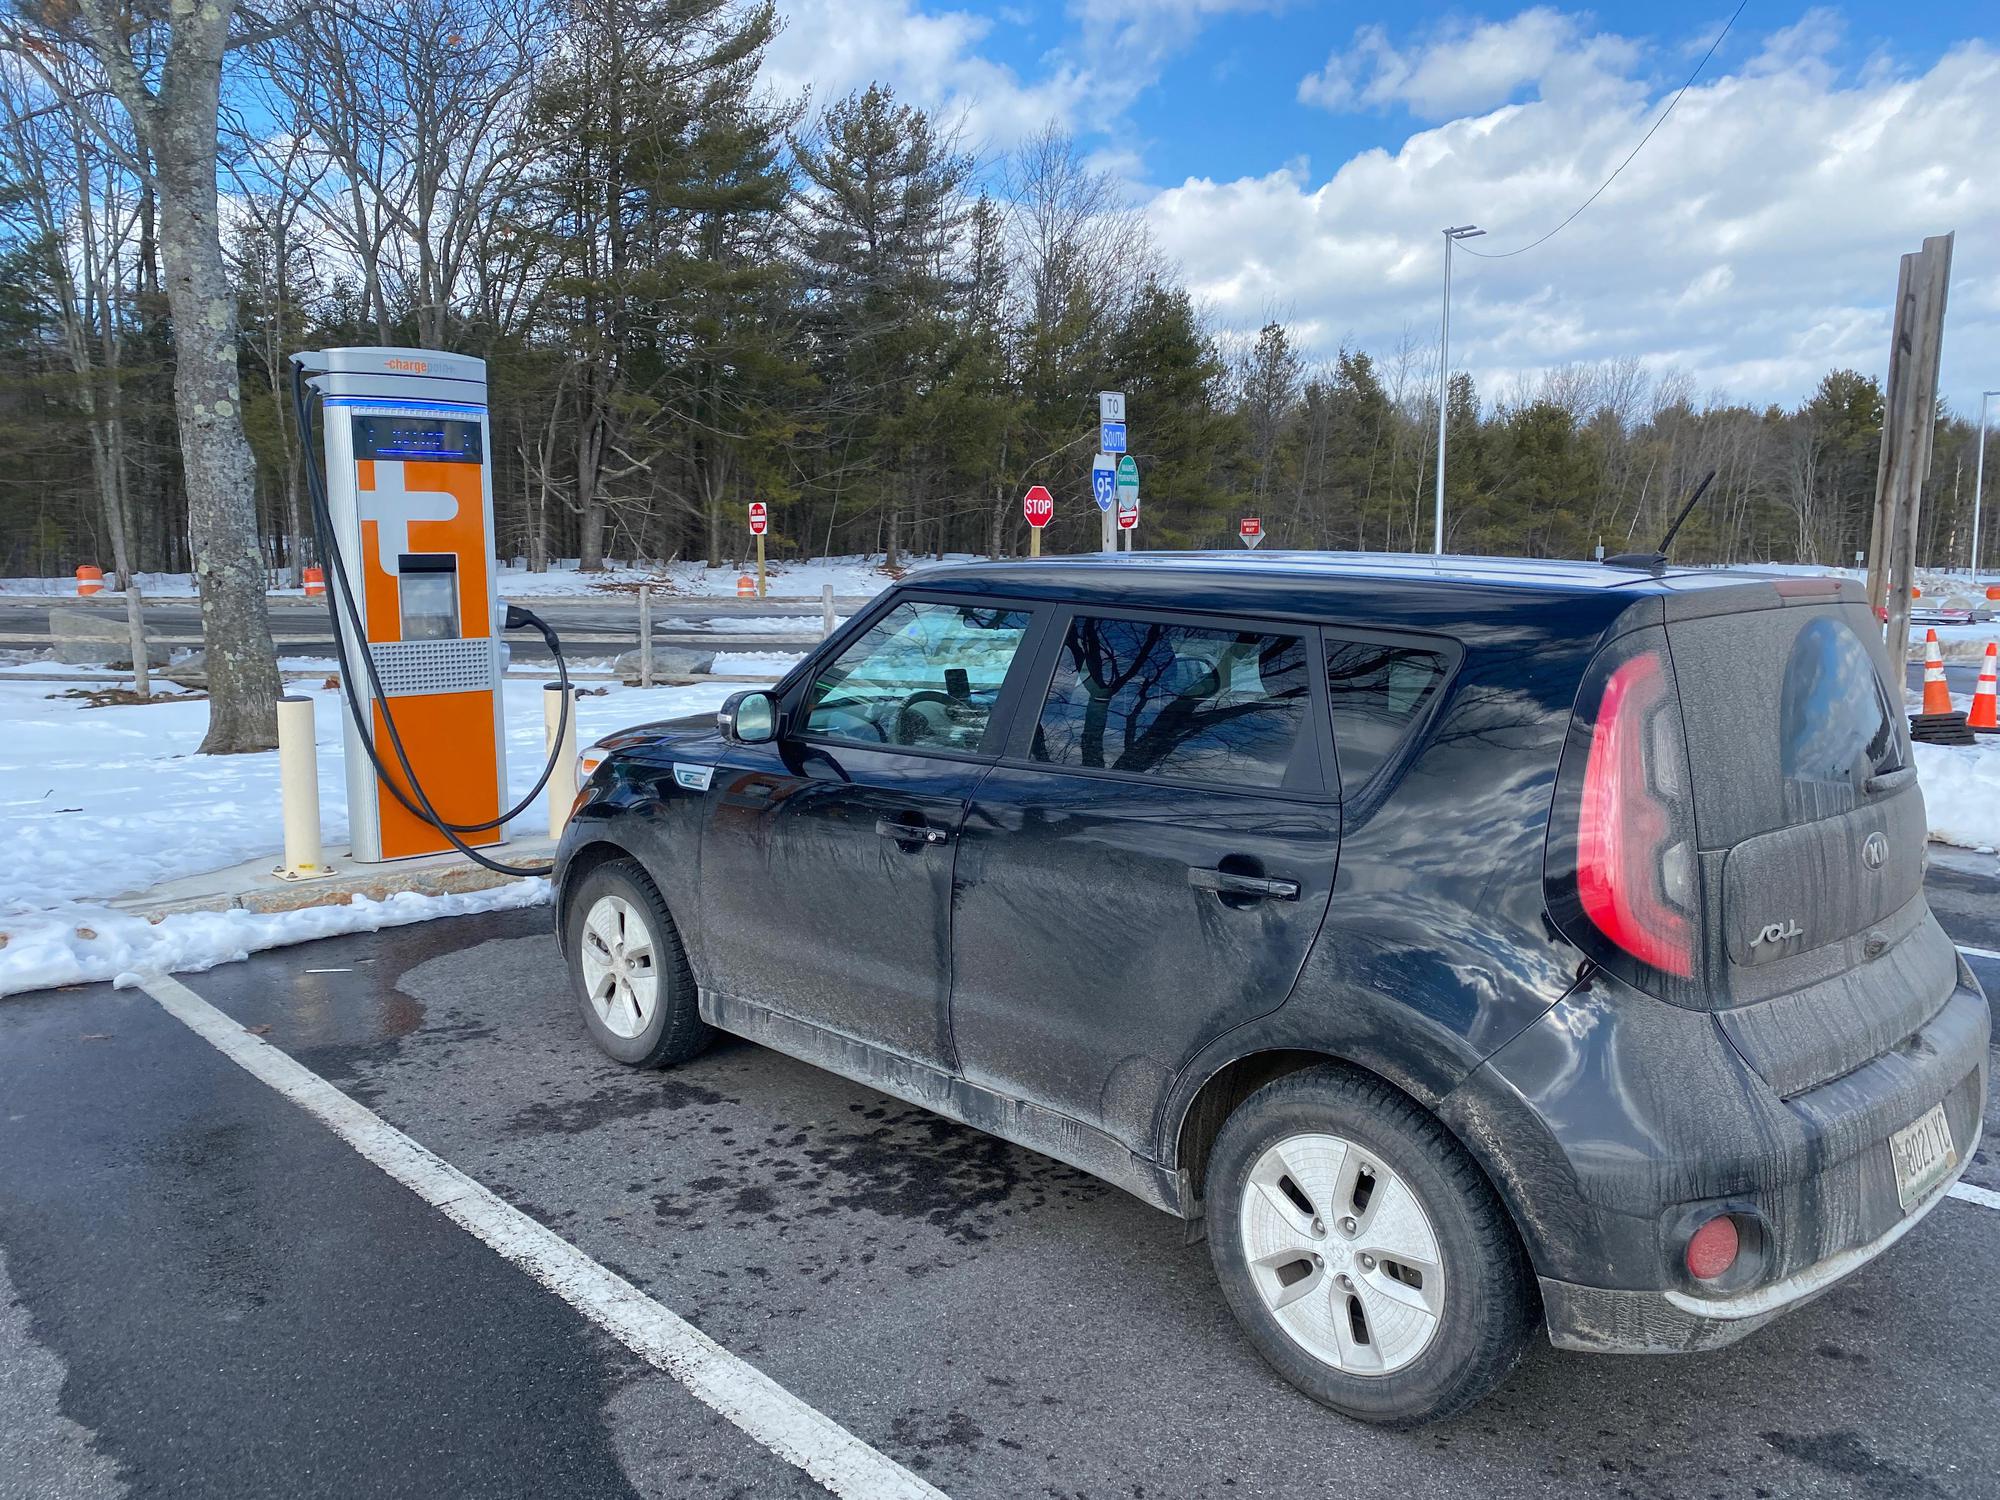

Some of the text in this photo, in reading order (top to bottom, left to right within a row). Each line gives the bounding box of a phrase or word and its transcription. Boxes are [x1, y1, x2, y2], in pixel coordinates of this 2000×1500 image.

[1107, 398, 1119, 414] TO
[1104, 428, 1125, 448] SOUTH
[1097, 477, 1112, 503] 95
[1026, 499, 1051, 515] STOP
[1905, 1122, 1935, 1176] 8021
